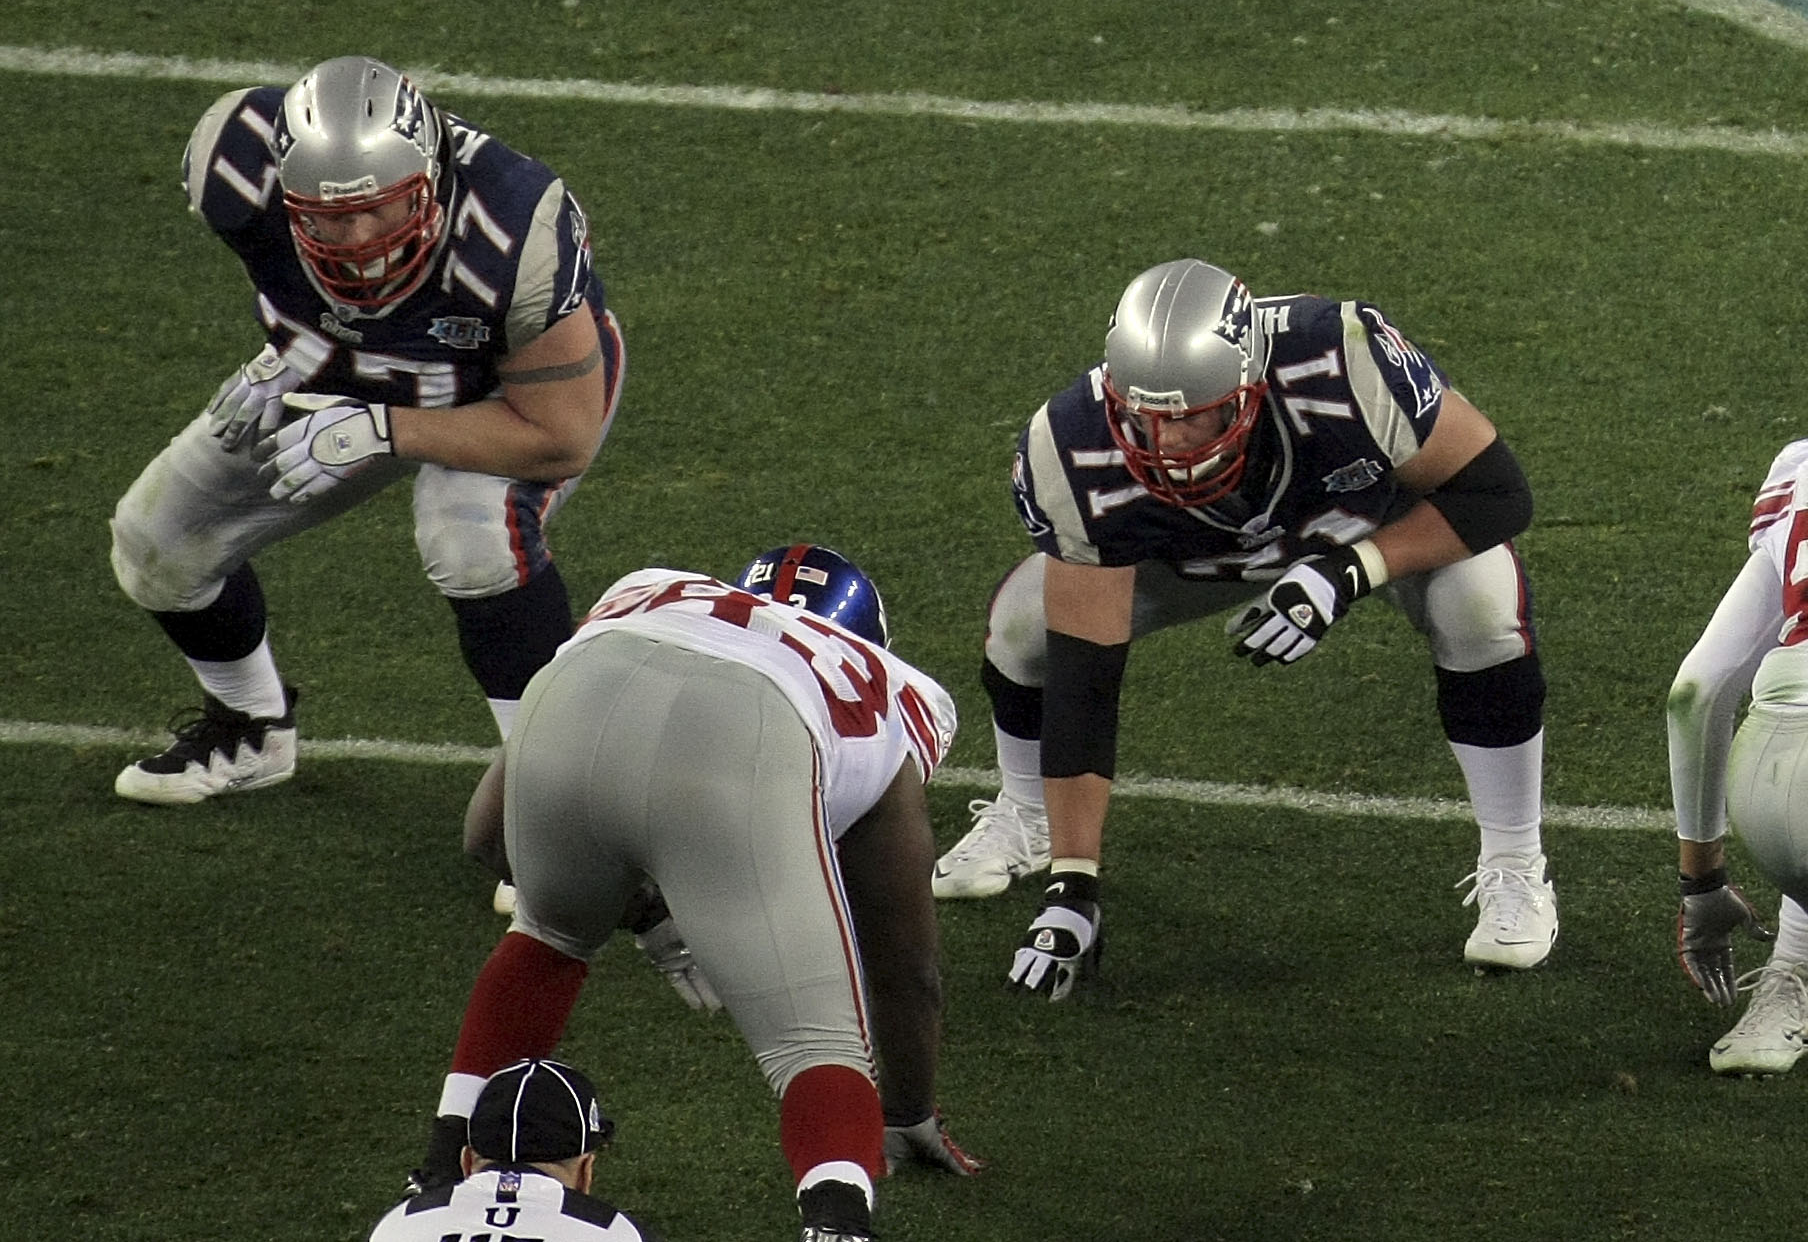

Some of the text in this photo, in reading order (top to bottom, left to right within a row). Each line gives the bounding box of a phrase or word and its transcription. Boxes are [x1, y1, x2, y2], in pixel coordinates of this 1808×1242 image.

[441, 188, 514, 308] 77
[1274, 348, 1354, 436] 71
[485, 1207, 521, 1228] U
